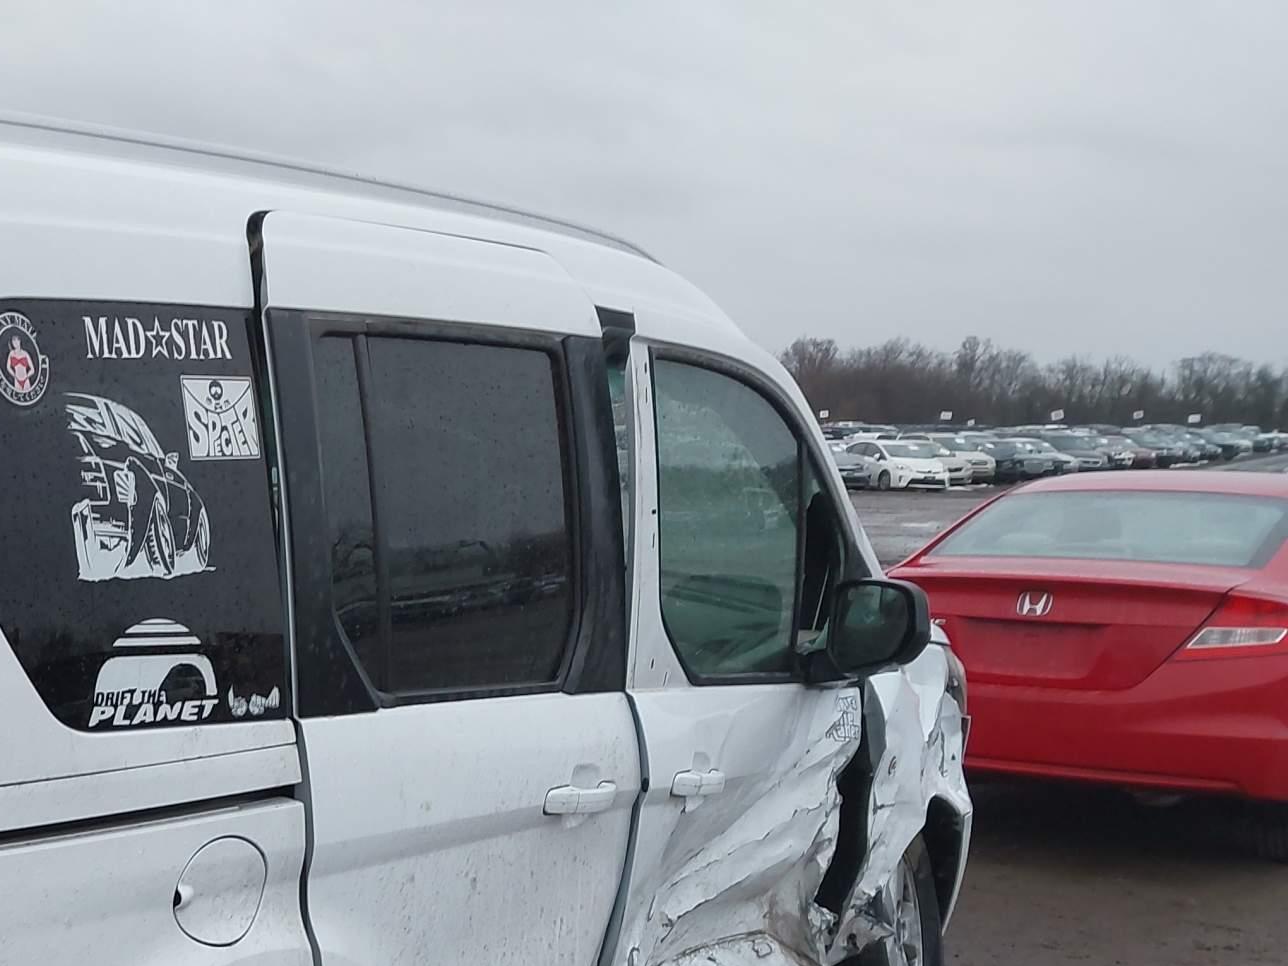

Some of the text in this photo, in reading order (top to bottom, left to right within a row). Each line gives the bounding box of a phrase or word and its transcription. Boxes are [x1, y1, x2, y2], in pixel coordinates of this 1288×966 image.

[82, 316, 233, 360] MAD STAR
[183, 385, 260, 458] SPECTER
[88, 699, 219, 728] PLANET
[95, 688, 137, 707] DRIFT
